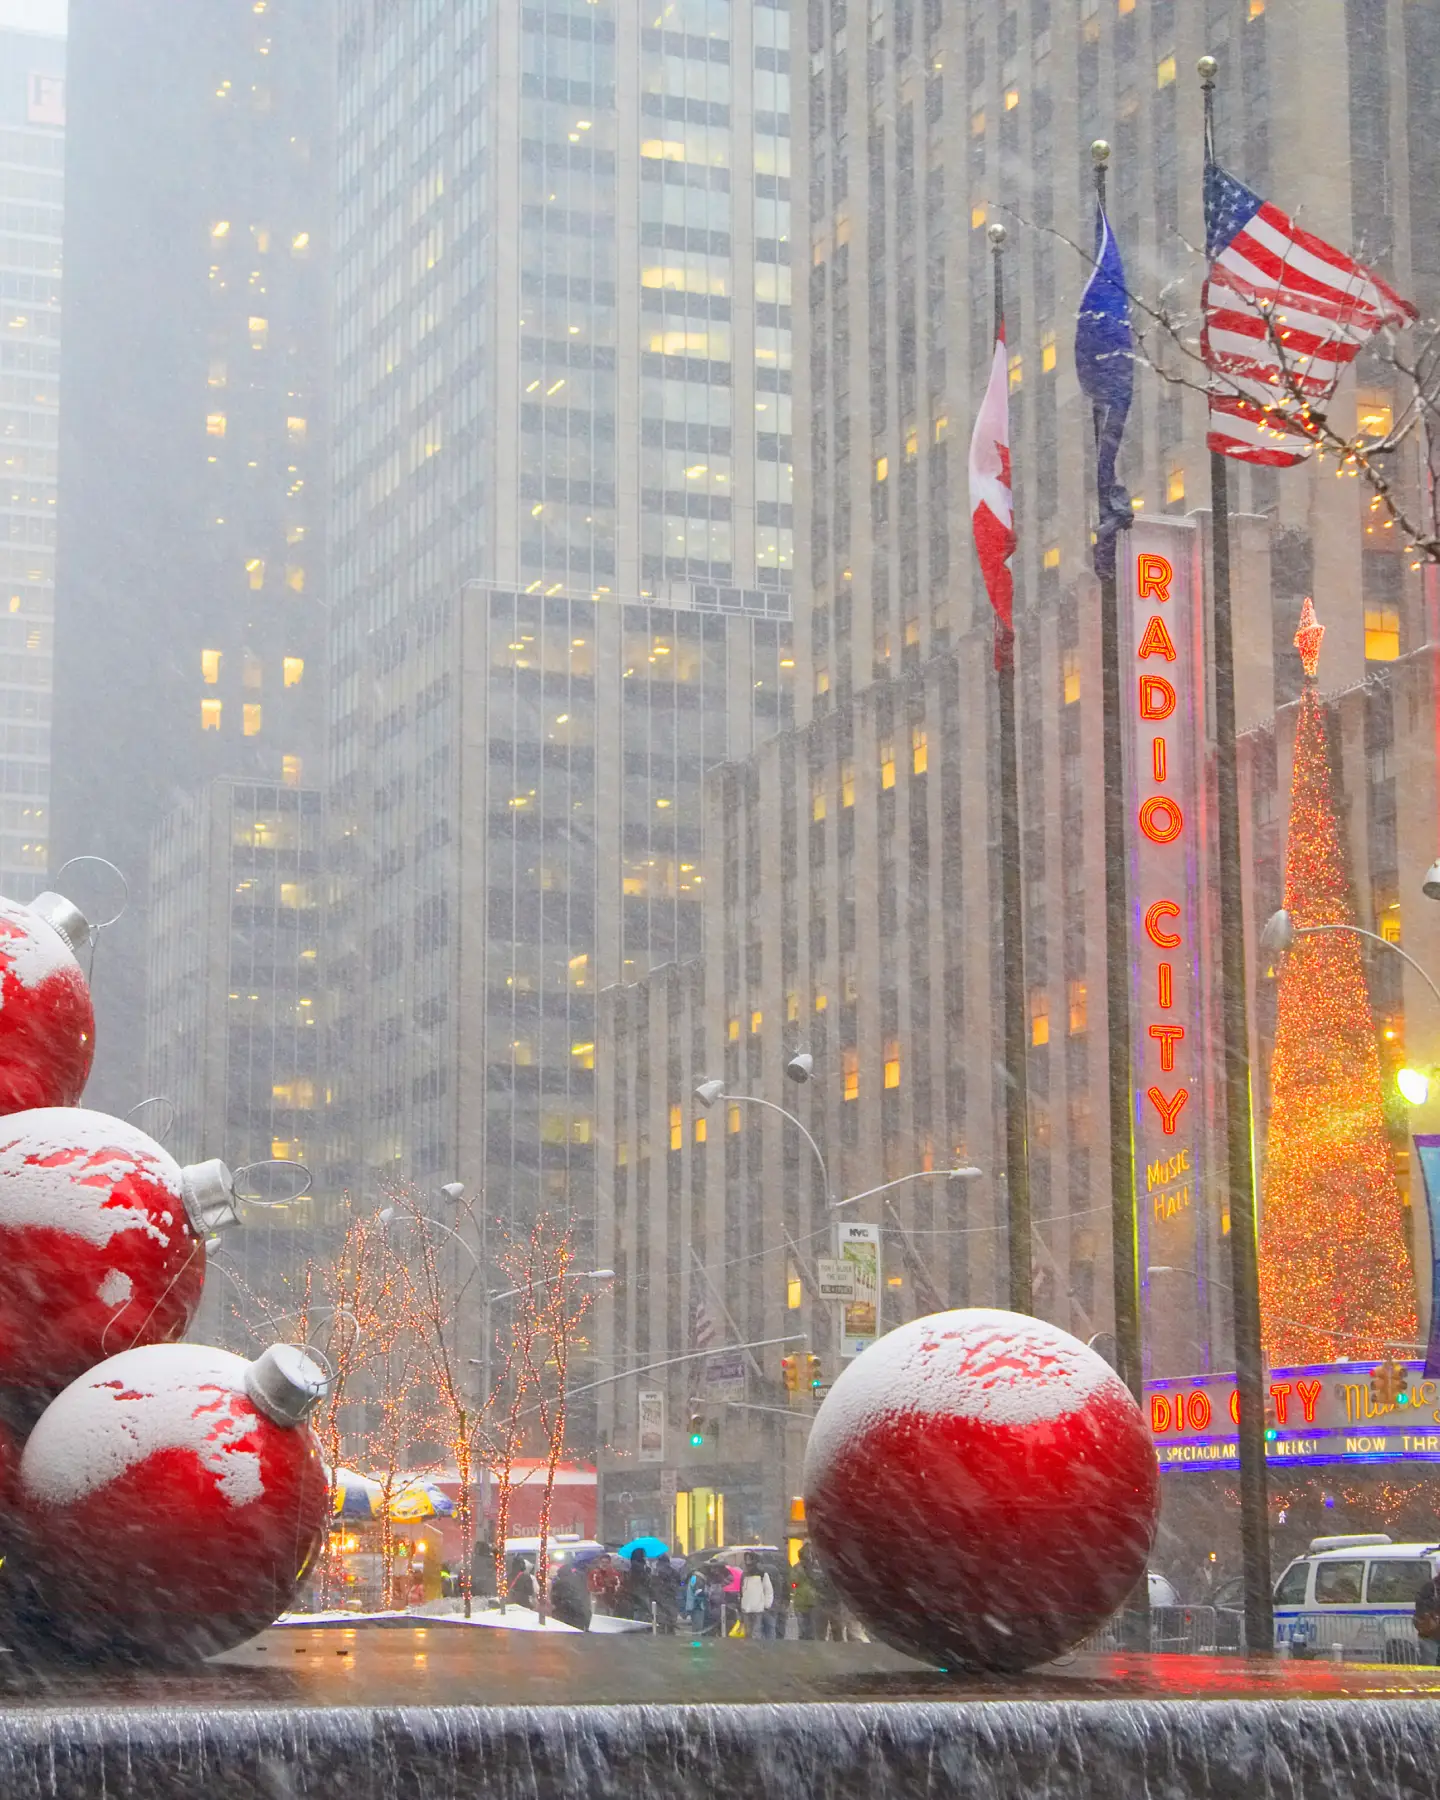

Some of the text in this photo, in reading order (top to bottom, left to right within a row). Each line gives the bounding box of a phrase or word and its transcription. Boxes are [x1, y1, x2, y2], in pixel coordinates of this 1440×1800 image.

[1138, 553, 1189, 1135] RADIO CITY
[849, 1228, 869, 1237] NYC
[1166, 1443, 1236, 1461] SPECTACULAR
[1346, 1437, 1386, 1453] NOW
[1402, 1436, 1439, 1452] THR
